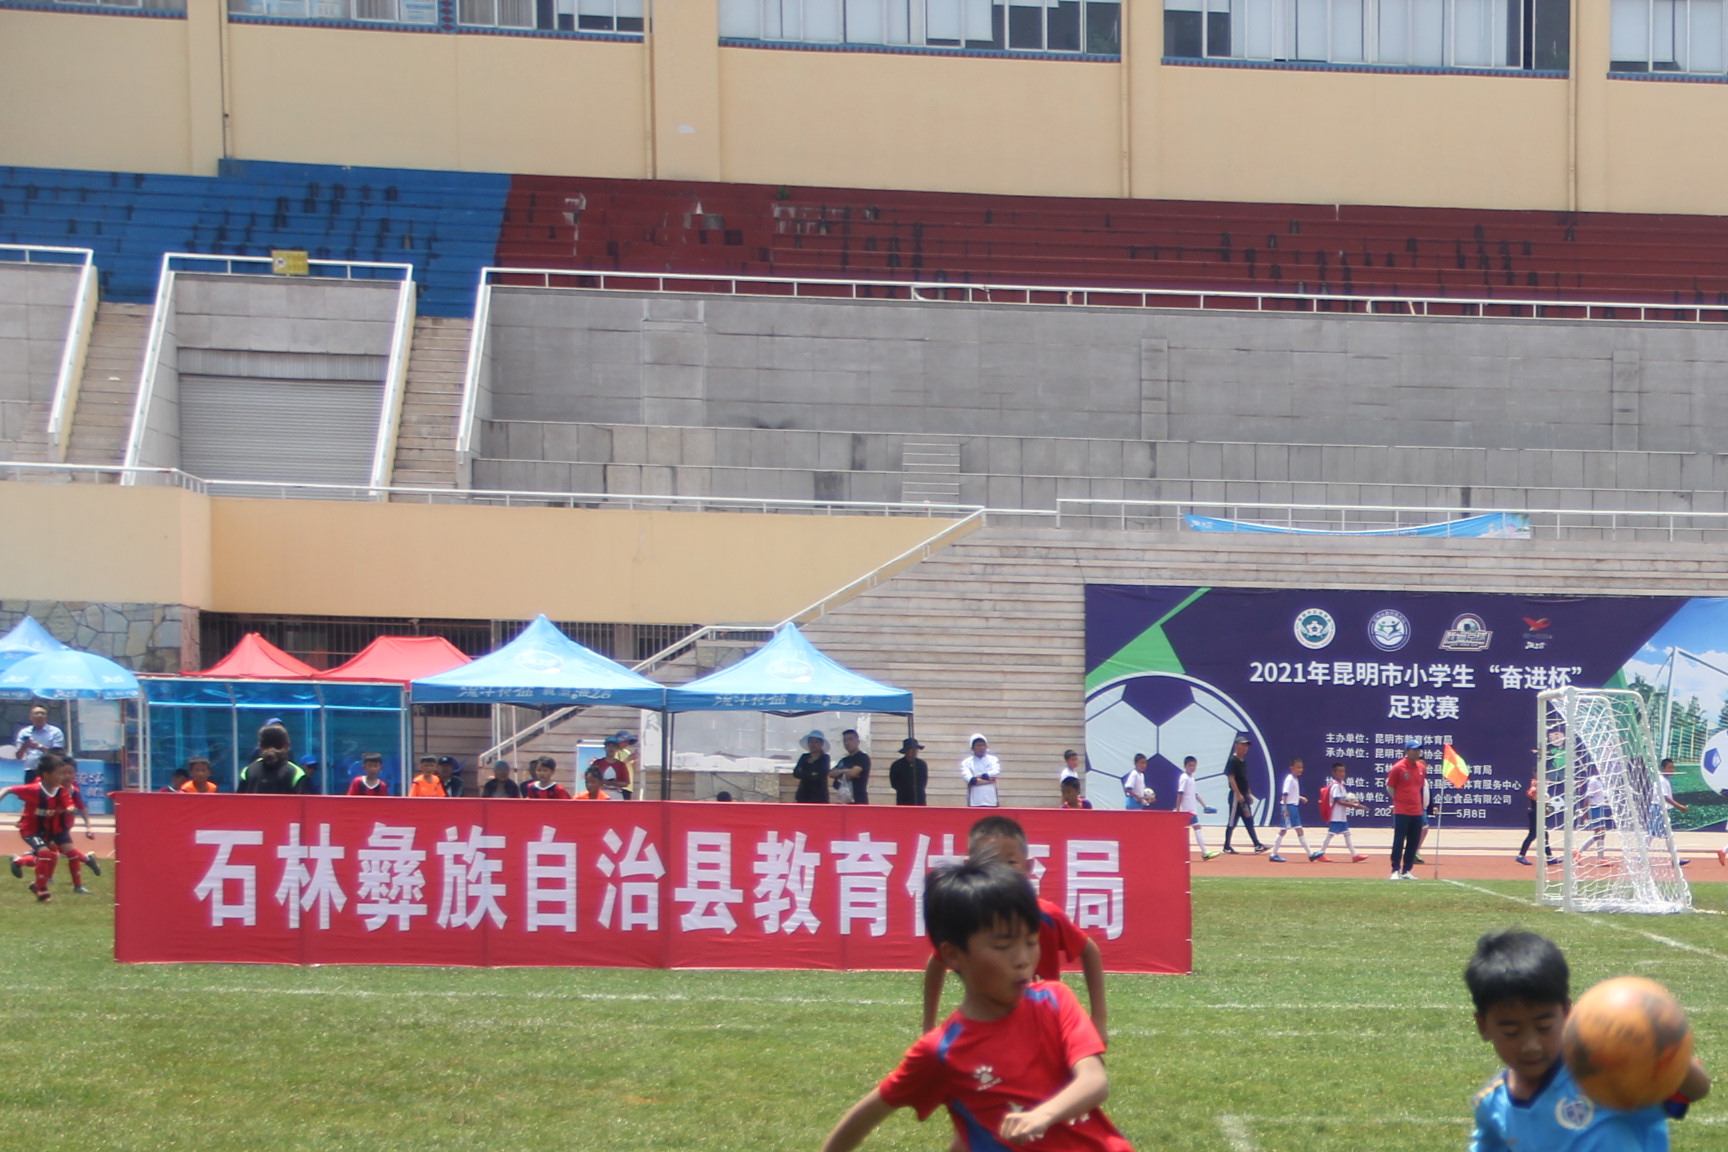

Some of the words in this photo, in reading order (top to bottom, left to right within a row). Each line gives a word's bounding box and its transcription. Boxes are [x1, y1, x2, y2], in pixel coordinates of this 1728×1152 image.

[1387, 694, 1460, 720] 足球赛
[1325, 748, 1443, 760] 承办单位：昆明市协会
[193, 821, 1125, 941] 石林彝族自治县教育体局
